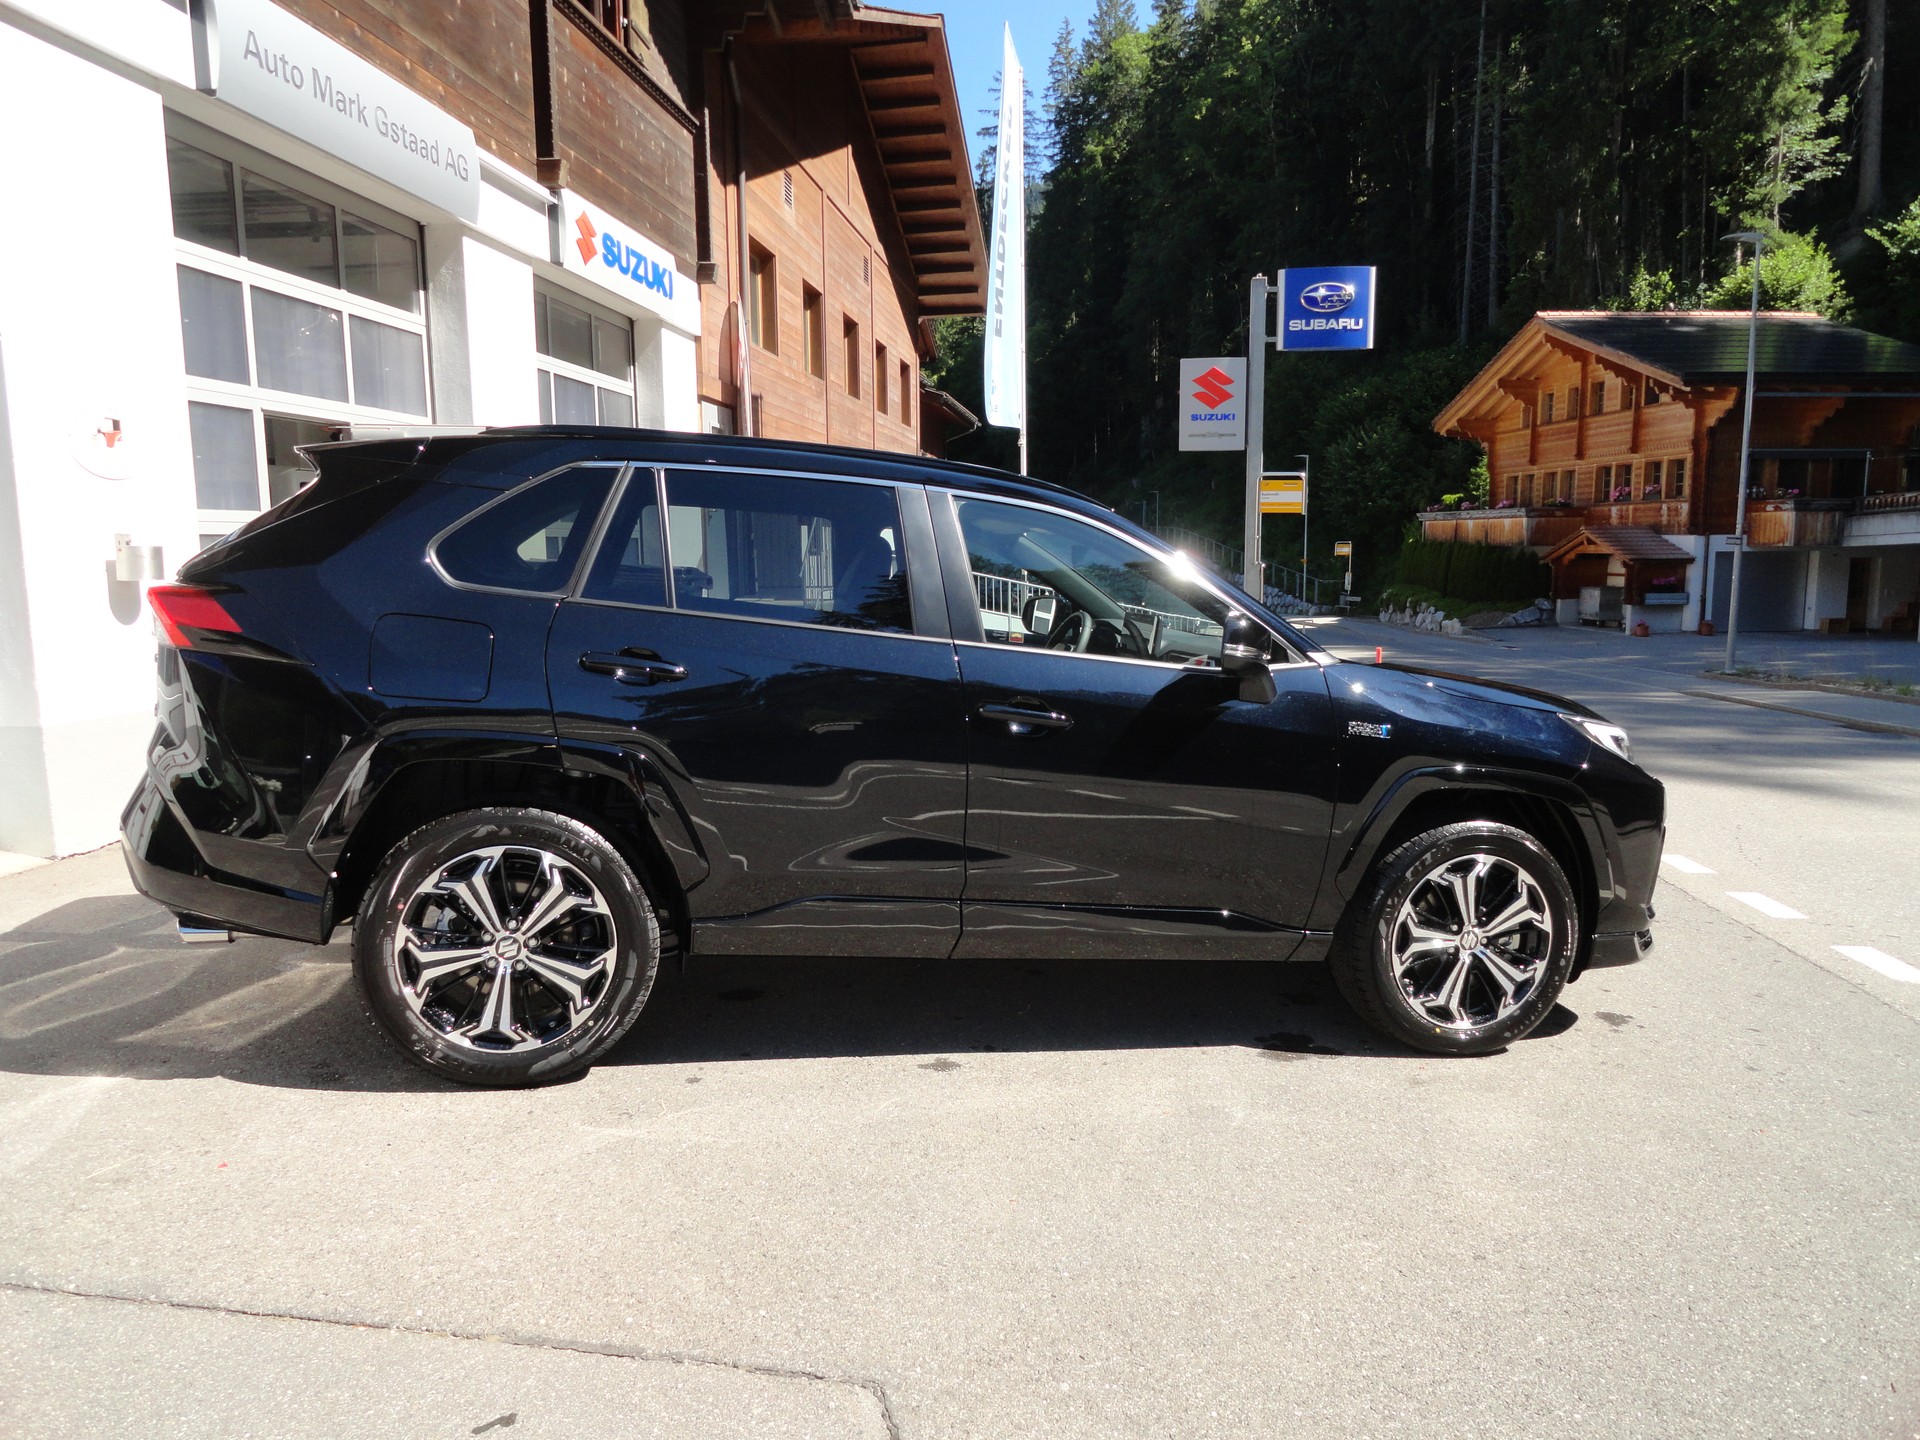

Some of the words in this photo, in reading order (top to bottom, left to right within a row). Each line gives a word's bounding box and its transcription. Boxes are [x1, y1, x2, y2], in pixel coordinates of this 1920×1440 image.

[243, 29, 304, 90] Auto
[312, 66, 369, 129] Mark
[375, 105, 440, 168] Gstaad
[444, 146, 470, 183] AG
[601, 232, 673, 300] SUZUKI
[1288, 318, 1363, 331] SUBARU
[1190, 413, 1236, 422] SUZUKI
